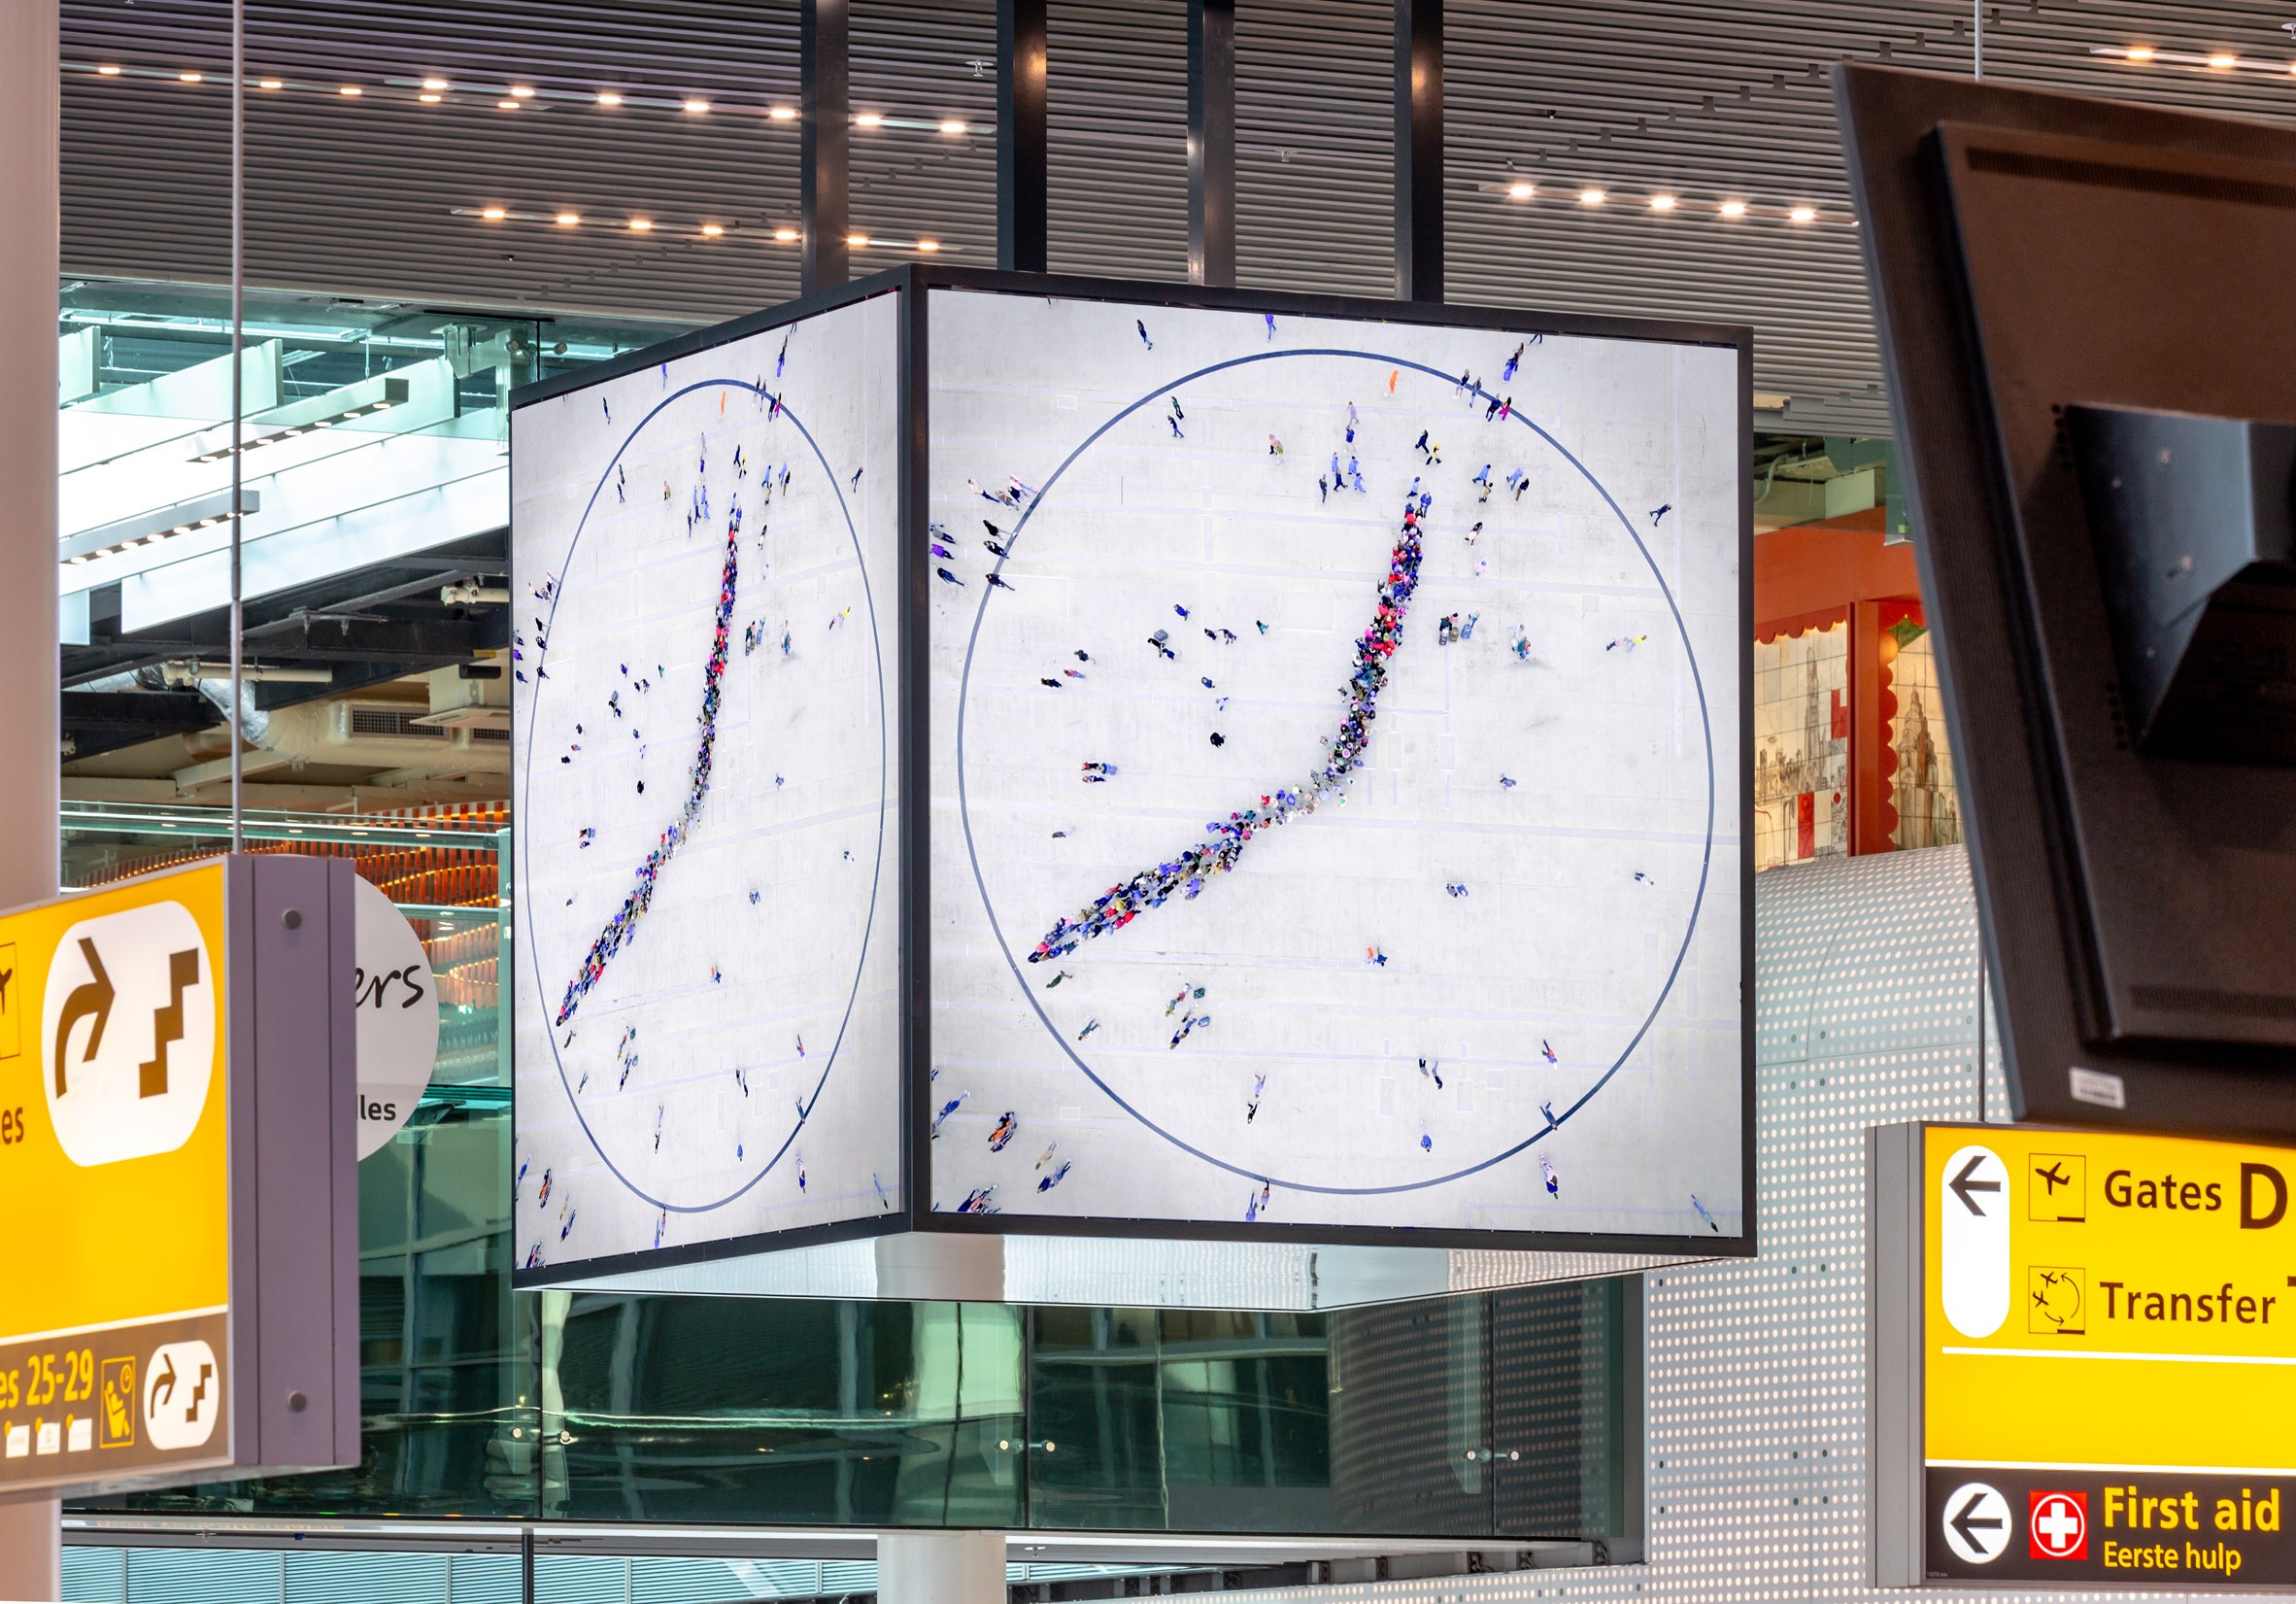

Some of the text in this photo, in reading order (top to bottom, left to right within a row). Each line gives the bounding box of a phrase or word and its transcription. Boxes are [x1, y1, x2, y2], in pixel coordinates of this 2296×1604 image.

[1, 1107, 24, 1145] es
[360, 1094, 396, 1121] les
[2104, 1162, 2288, 1230] Gates D
[2099, 1280, 2277, 1324] Transfer
[26, 1348, 94, 1407] 25-29
[2104, 1485, 2279, 1531] First aid
[2104, 1541, 2242, 1576] Eerste hulp
